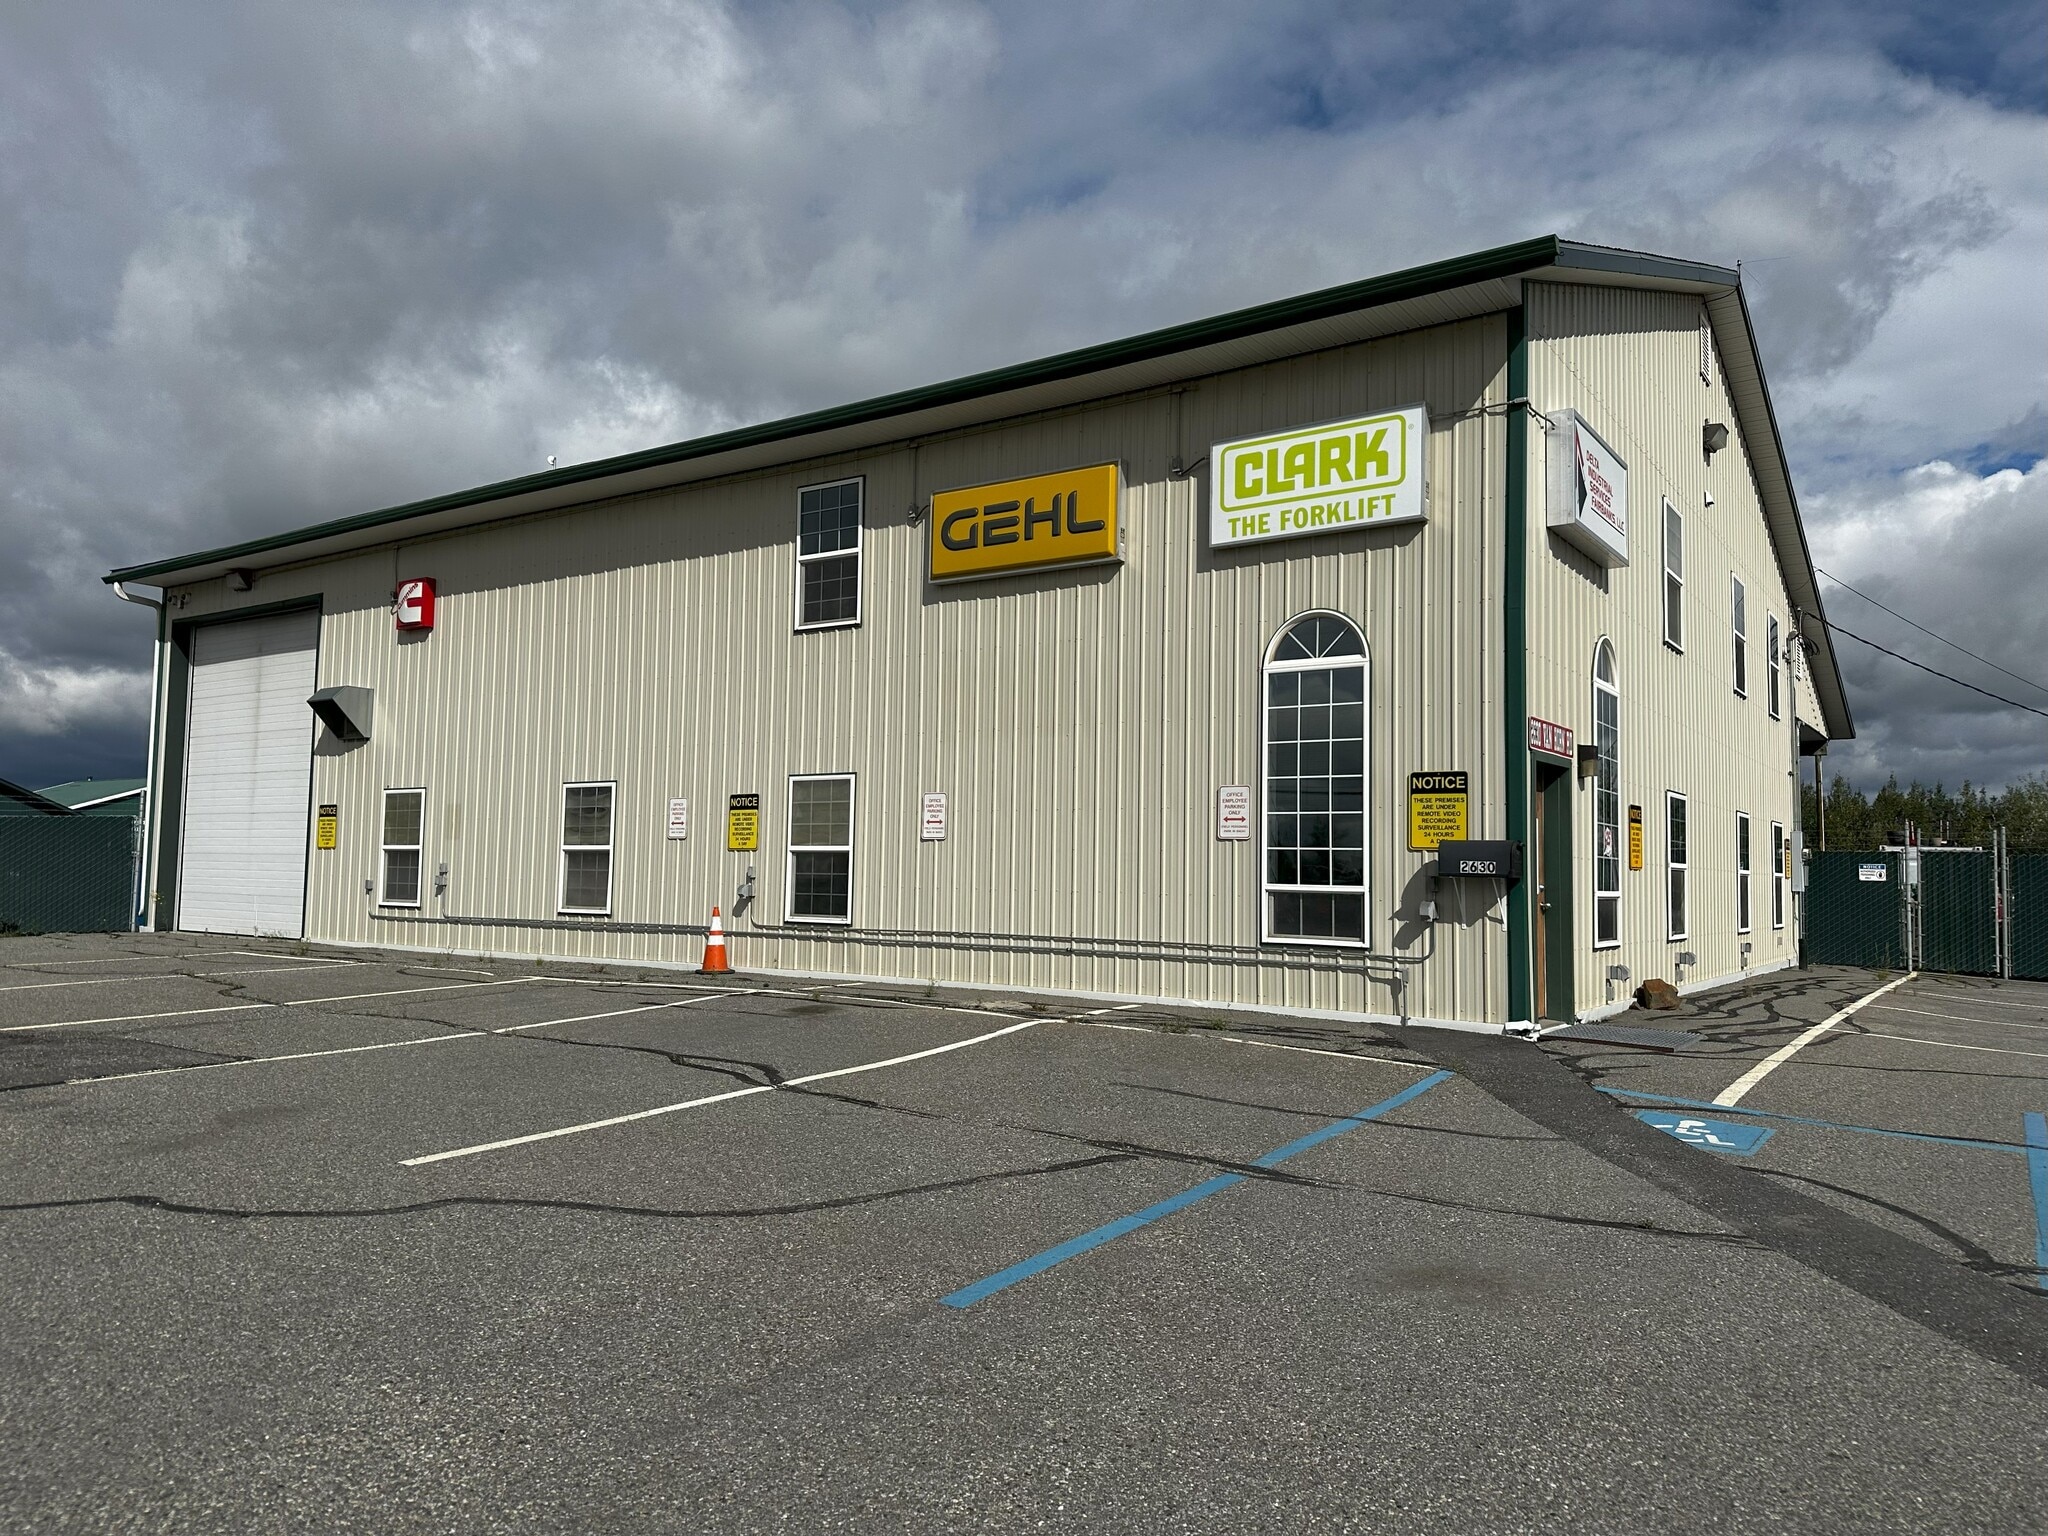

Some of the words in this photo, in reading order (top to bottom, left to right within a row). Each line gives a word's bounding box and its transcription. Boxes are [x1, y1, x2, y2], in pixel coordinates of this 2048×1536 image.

[1235, 428, 1389, 499] CLARK
[1586, 450, 1599, 471] DELTA
[1587, 465, 1613, 497] INDUSTRIAL
[1590, 480, 1611, 507] SERVICES
[941, 490, 1105, 551] GEHL
[1228, 513, 1270, 538] THE
[1280, 493, 1396, 531] FORKLIFT
[1412, 776, 1466, 789] NOTICE
[320, 807, 337, 815] NOTICE
[731, 797, 758, 807] NOTICE
[1461, 861, 1496, 873] 2630
